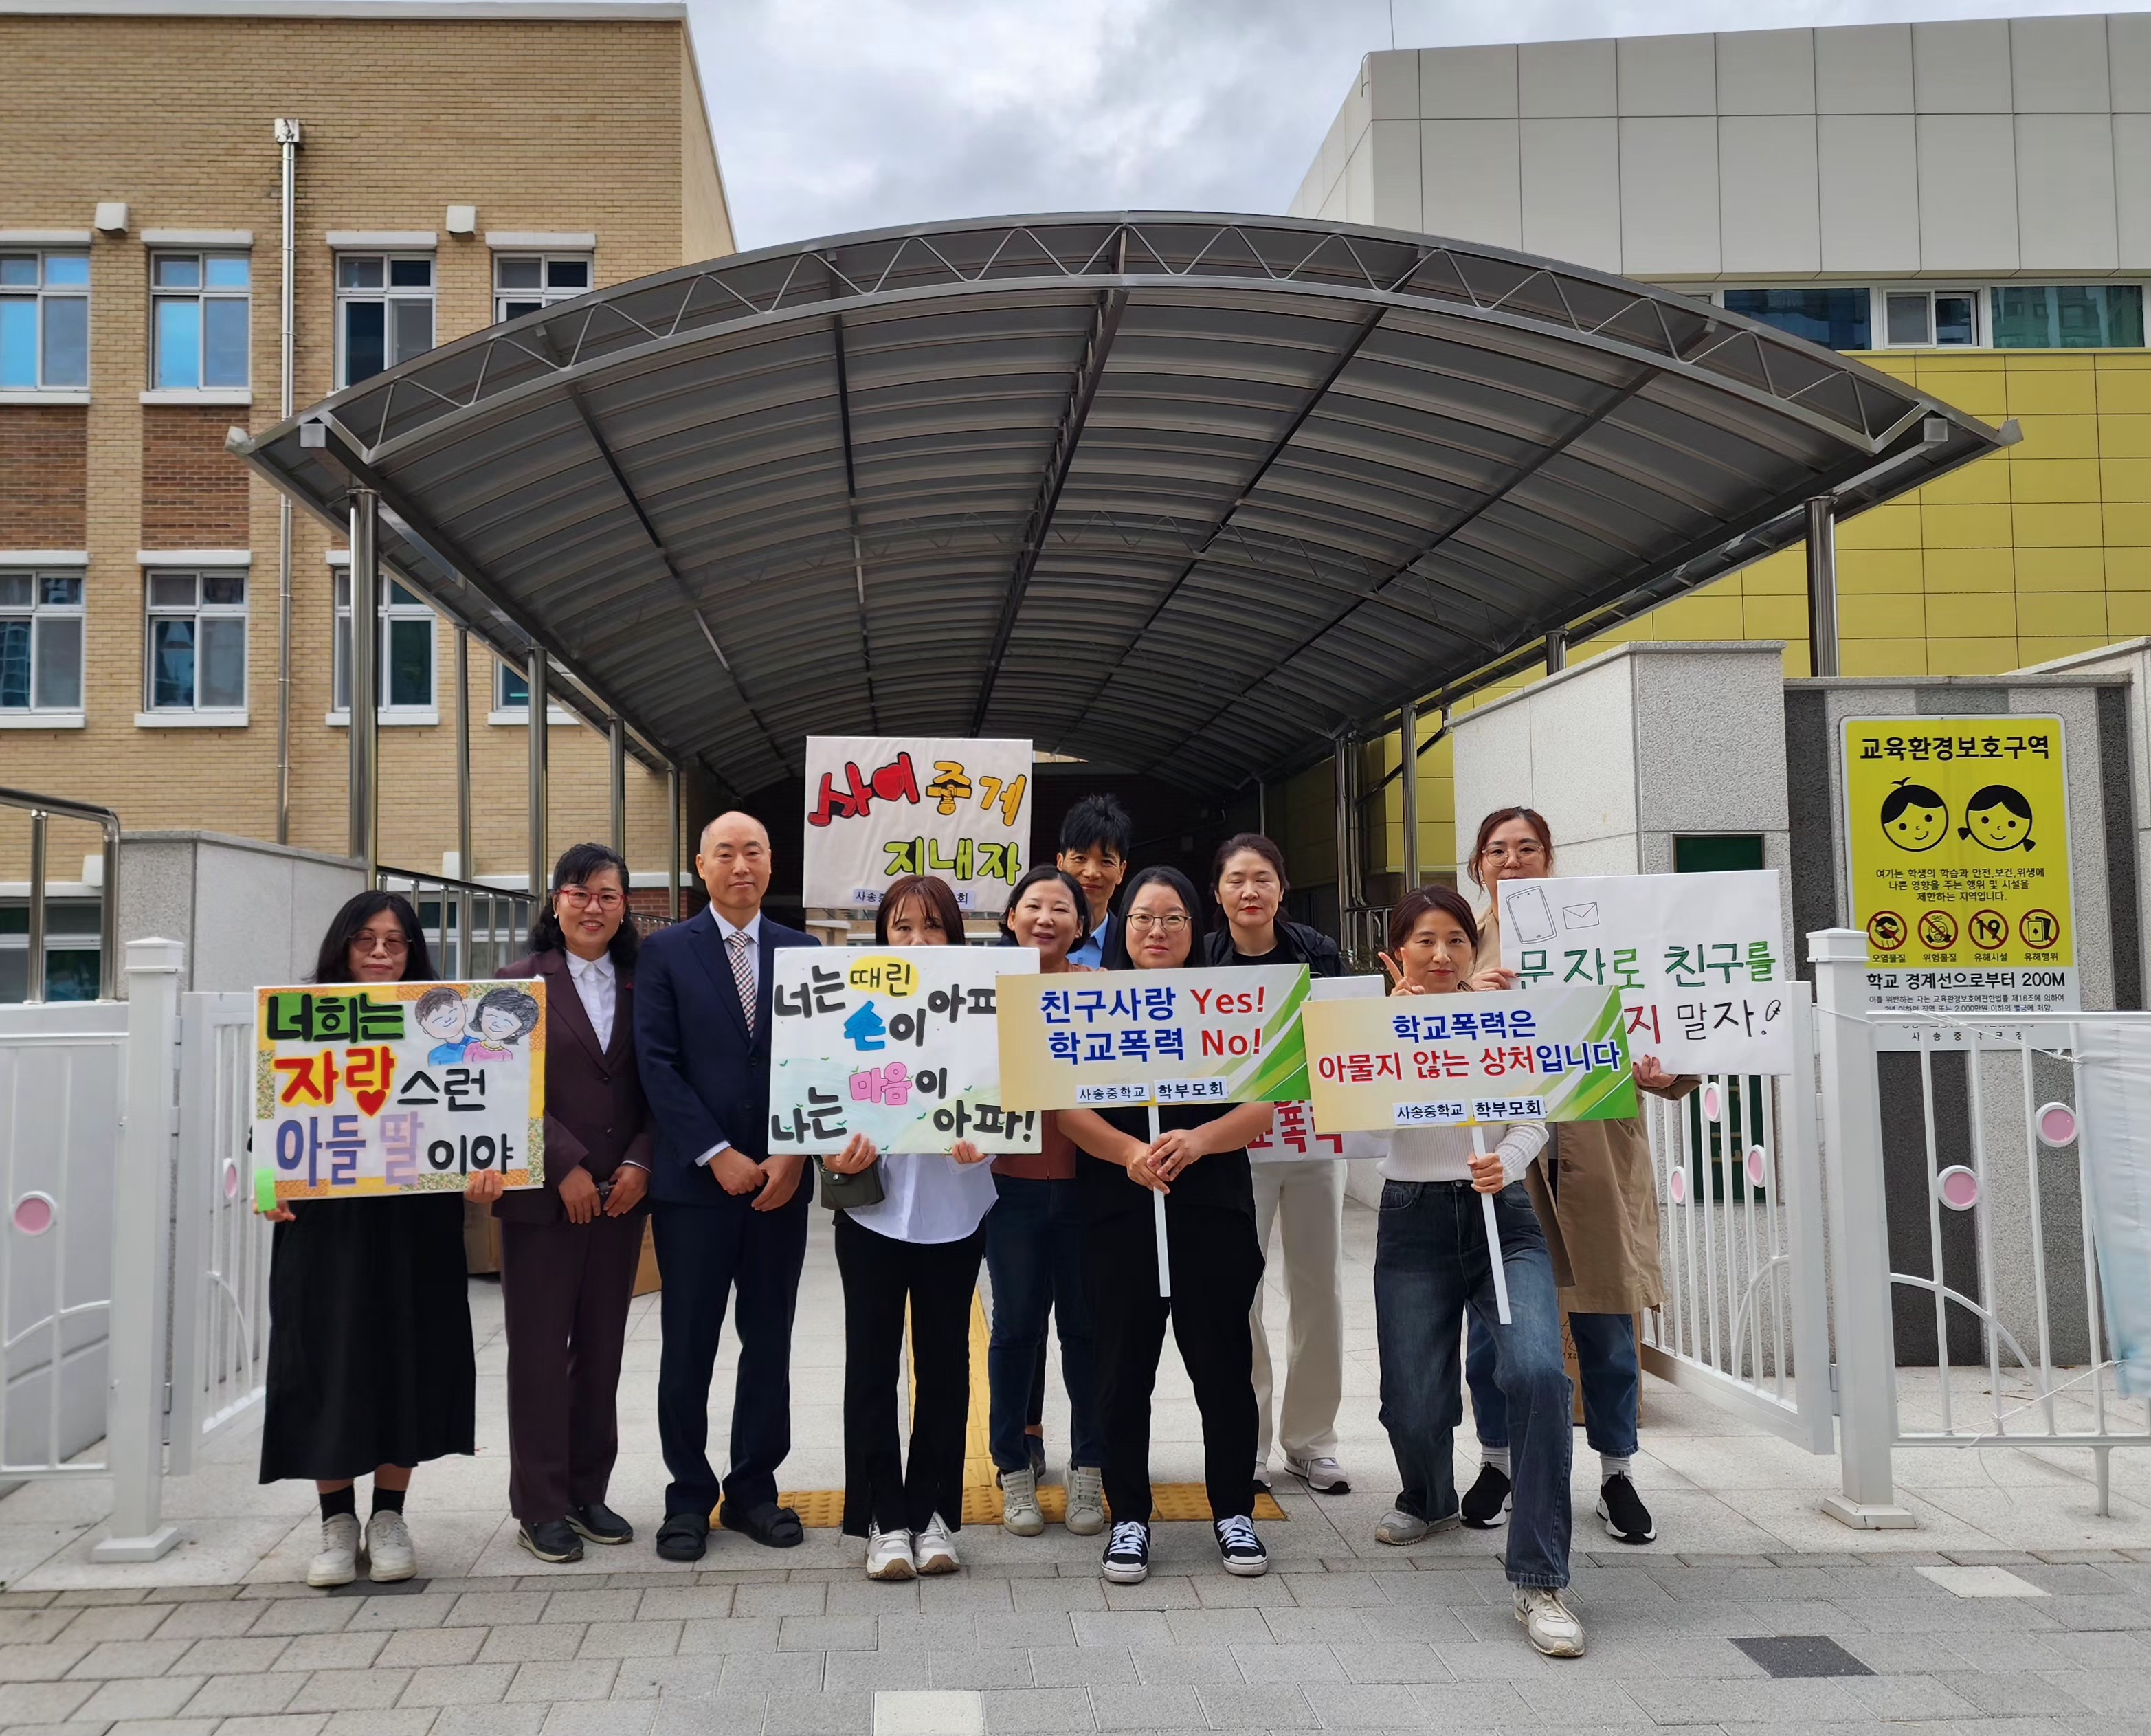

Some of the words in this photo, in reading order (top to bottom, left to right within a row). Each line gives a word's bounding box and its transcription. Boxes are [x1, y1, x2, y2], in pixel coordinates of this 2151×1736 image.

[1860, 735, 2049, 761] 교육환경보호구역
[884, 836, 1022, 886] 지내자
[1876, 869, 1904, 879] 여기는
[1907, 869, 1935, 879] 학생의
[1940, 868, 1969, 878] 학습과
[1888, 880, 1908, 891] 나쁜
[1911, 880, 1940, 891] 영향을
[1943, 880, 1962, 890] 주는
[1966, 880, 1985, 890] 행위
[1989, 880, 1998, 890] 및
[2002, 879, 2029, 889] 시설을
[1917, 892, 1955, 902] 제한하는
[1959, 891, 2007, 902] 지역입니다.
[1976, 919, 2000, 940] 19
[1664, 940, 1776, 988] 친구를
[1872, 954, 1906, 963] 오염물질
[1923, 953, 1957, 962] 위험물질
[1974, 953, 2008, 962] 유해시설
[2024, 952, 2059, 961] 유해행위
[774, 964, 846, 1019] 너는
[850, 963, 911, 997] 때린
[1866, 973, 1899, 990] 학교
[1905, 972, 2015, 990] 경계선으로부터
[2022, 972, 2066, 987] 200M
[1040, 986, 1177, 1024] 친구사랑
[1189, 986, 1265, 1015] Yes!
[1886, 995, 1913, 1003] 위반하는
[1917, 995, 1930, 1003] 자는
[2044, 994, 2064, 1002] 의하여
[267, 992, 404, 1043] 너희는
[844, 1000, 926, 1051] 손이
[1392, 1010, 1537, 1044] 학교폭력은
[1048, 1027, 1184, 1065] 학교폭력
[1201, 1028, 1262, 1056] No!
[1318, 1052, 1403, 1084] 아물지
[1413, 1050, 1469, 1080] 않는
[1479, 1041, 1621, 1077] 상처입니다
[1080, 1085, 1146, 1100] 사송중학교
[1157, 1082, 1223, 1099] 학부모회
[771, 1087, 848, 1144] 나는
[849, 1062, 947, 1106] 마음이
[933, 1100, 1035, 1142] 아파!
[1397, 1103, 1464, 1119] 사송중학교
[1475, 1100, 1541, 1117] 학부모회
